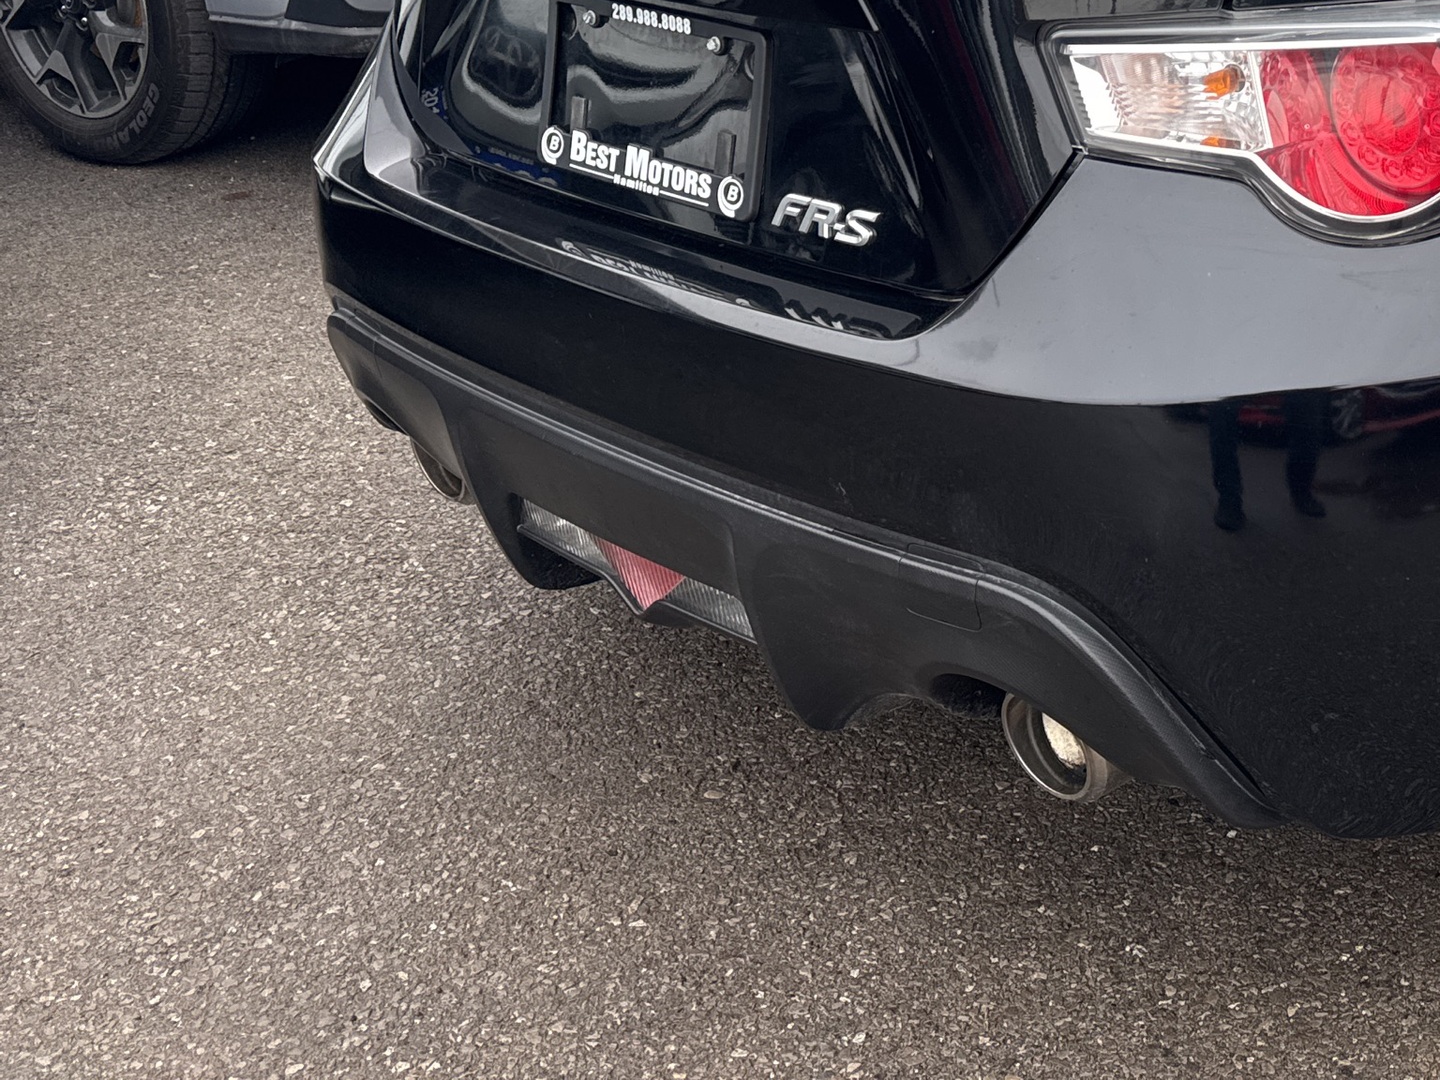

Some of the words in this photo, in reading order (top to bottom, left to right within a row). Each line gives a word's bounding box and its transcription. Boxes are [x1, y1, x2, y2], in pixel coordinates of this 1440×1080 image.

[612, 3, 691, 35] 289.988.8088
[569, 129, 620, 172] BEST
[624, 144, 713, 199] MOTORS
[613, 173, 660, 196] Hamilton
[771, 193, 884, 247] FR-S
